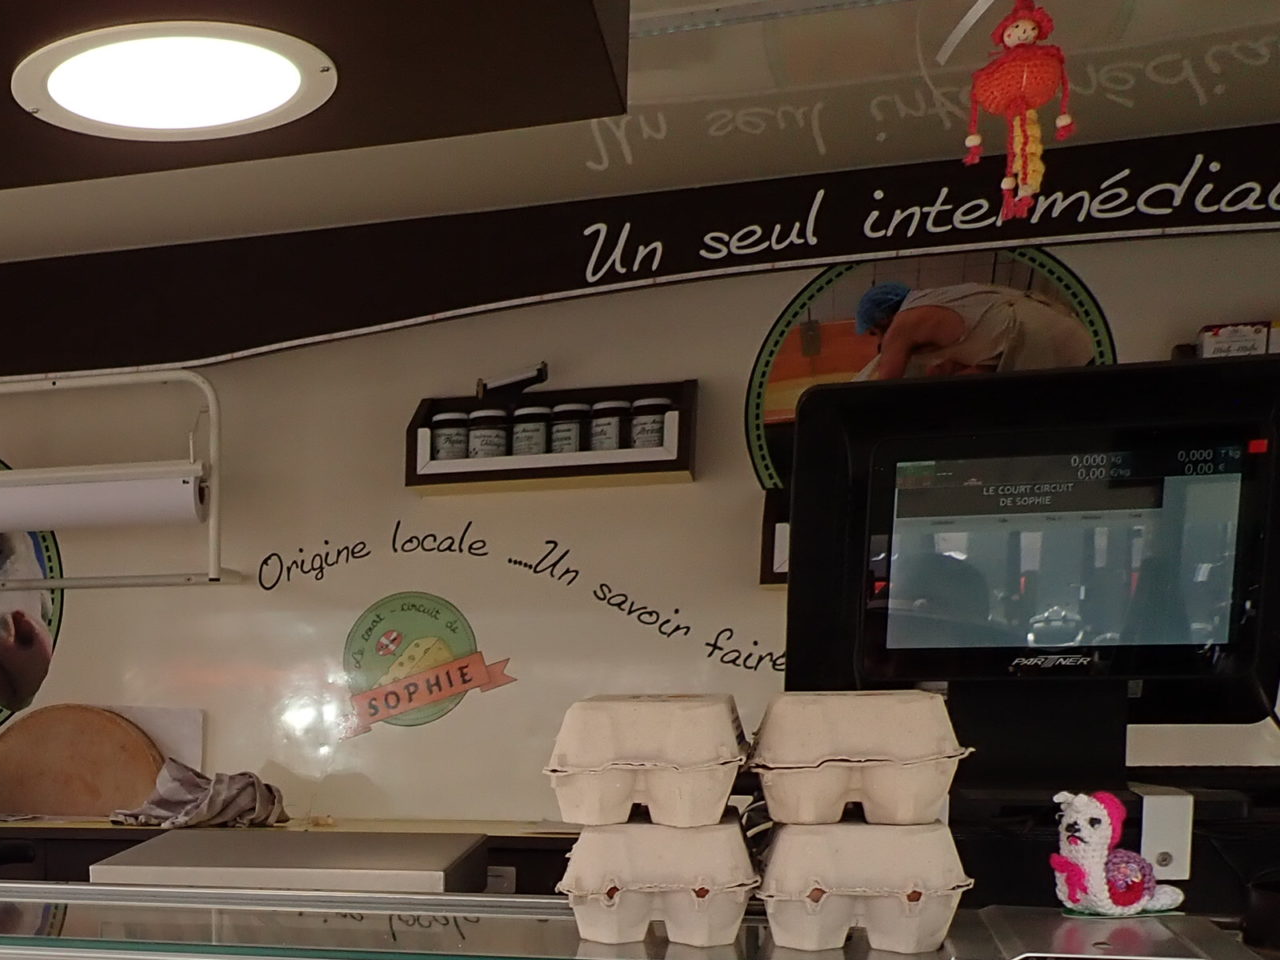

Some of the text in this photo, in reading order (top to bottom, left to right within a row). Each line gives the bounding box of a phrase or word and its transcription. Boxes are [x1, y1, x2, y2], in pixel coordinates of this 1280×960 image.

[582, 153, 1280, 283] Un seul intemédia
[983, 482, 1074, 496] LE COURT CIRCUIT
[999, 495, 1052, 506] DE SOPHIE
[257, 540, 372, 591] Origine
[391, 520, 489, 557] locale
[592, 582, 691, 638] savoir
[1011, 654, 1092, 668] PARTNER
[367, 662, 474, 718] SOPHIE
